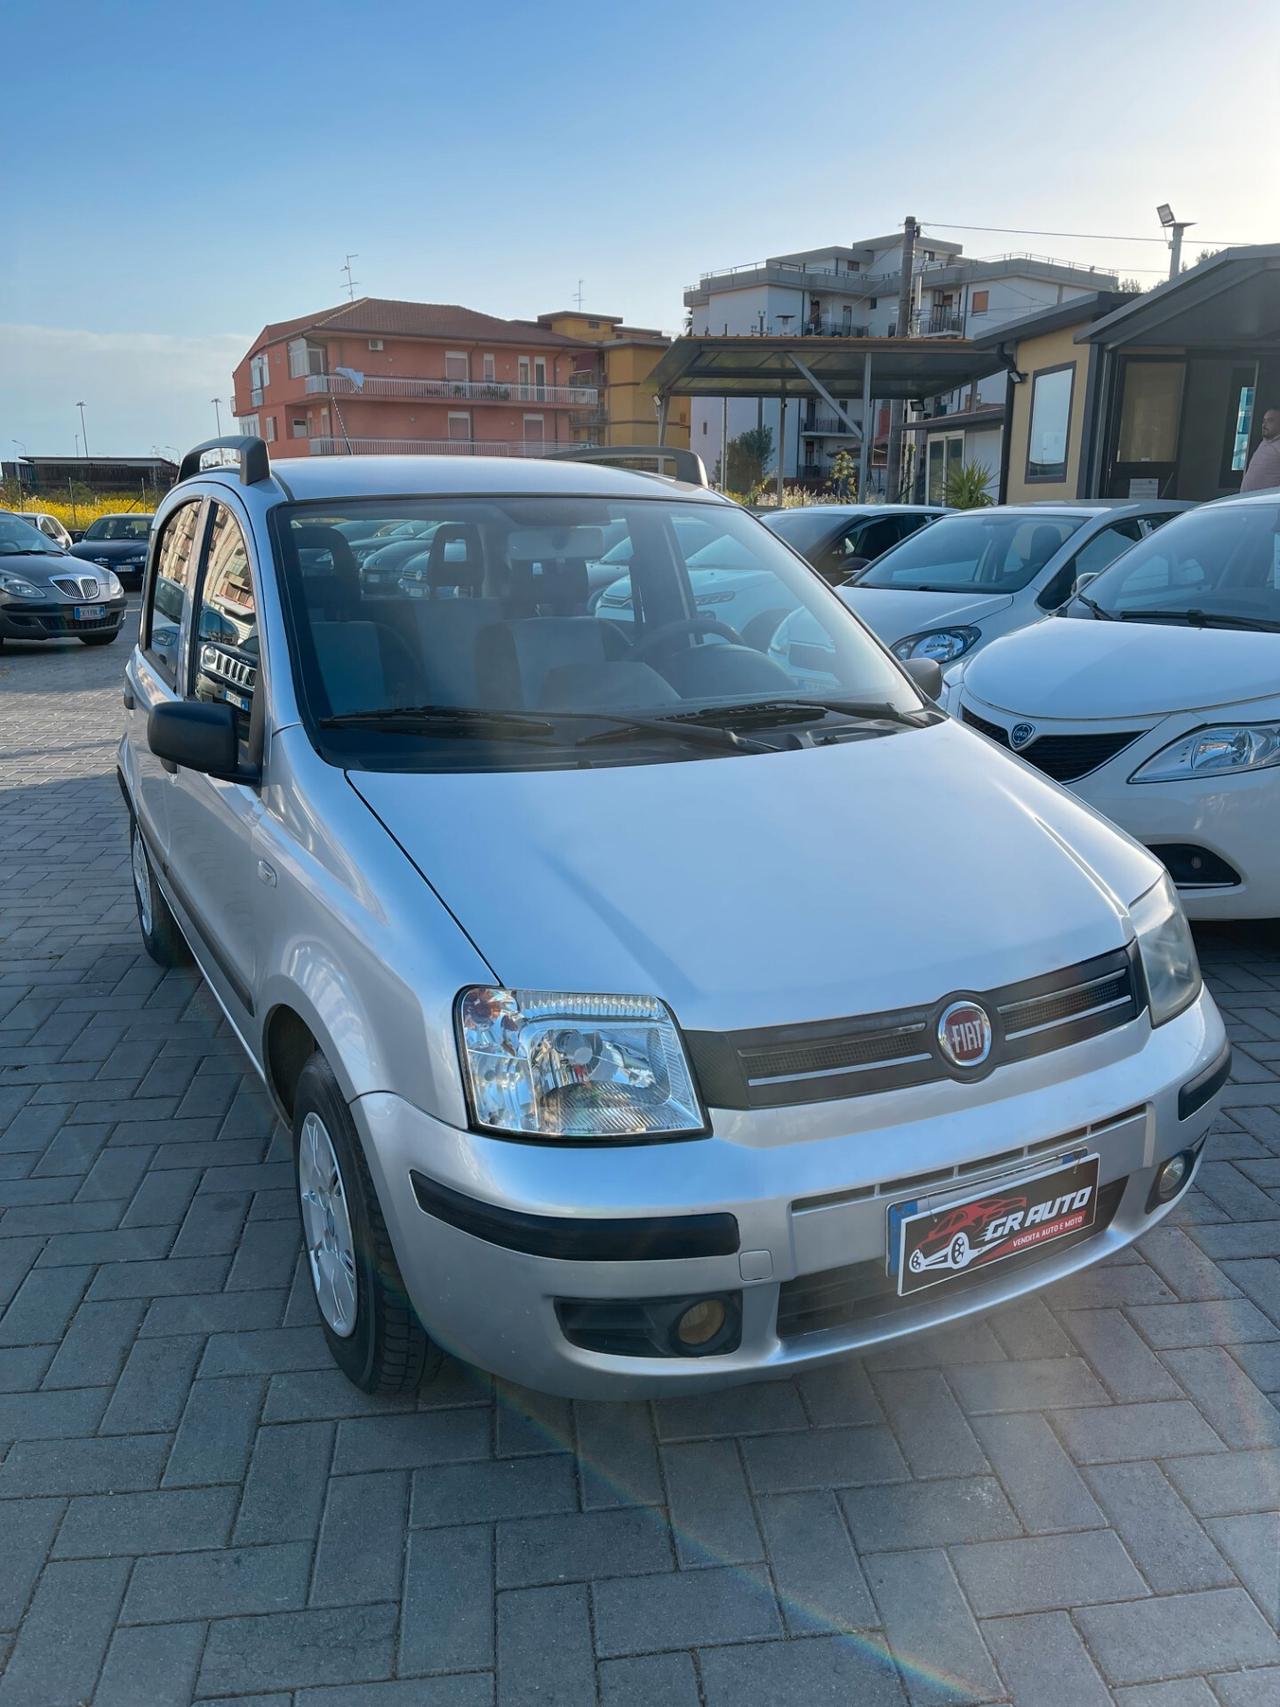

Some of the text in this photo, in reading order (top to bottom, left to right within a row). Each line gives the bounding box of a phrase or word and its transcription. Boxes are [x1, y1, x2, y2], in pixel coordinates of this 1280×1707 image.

[951, 1020, 982, 1054] FIAT
[984, 1186, 1093, 1241] GR AUTO
[1012, 1215, 1083, 1248] VENDITA AUTO E MOTO
